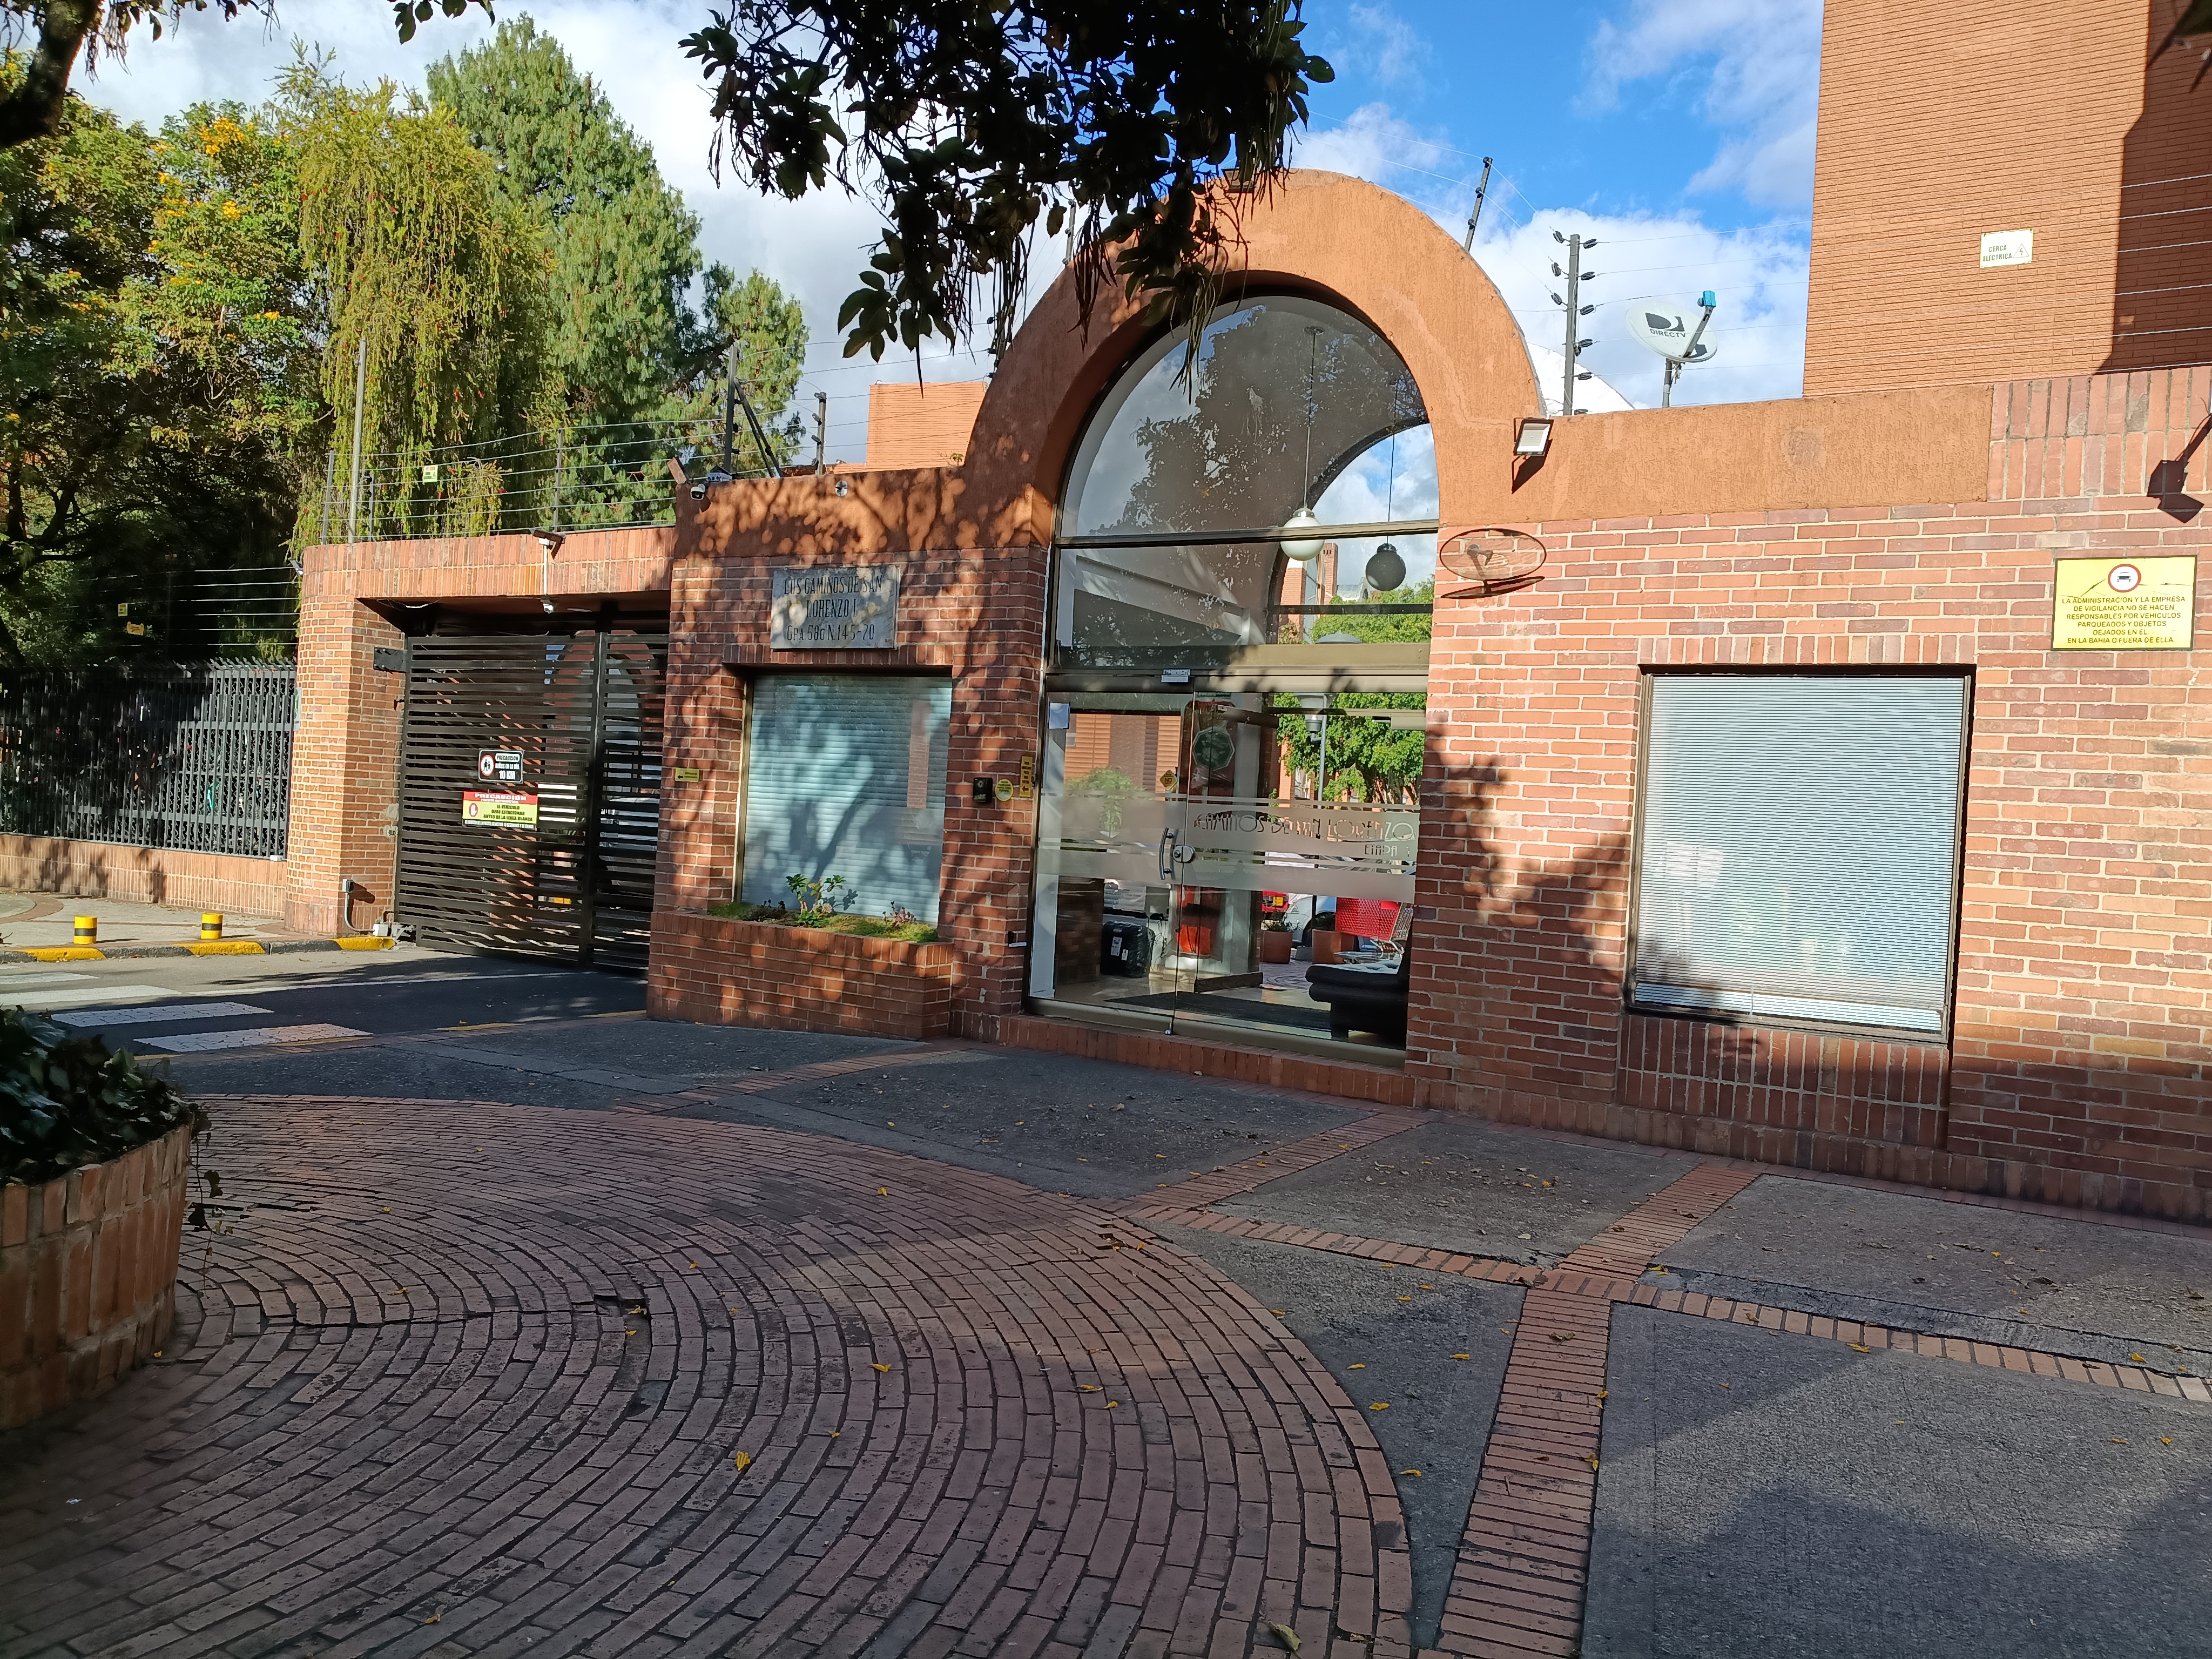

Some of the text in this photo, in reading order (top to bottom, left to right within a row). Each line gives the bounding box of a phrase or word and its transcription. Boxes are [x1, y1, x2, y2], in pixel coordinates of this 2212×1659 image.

[1983, 253, 2012, 261] ELECTRICA
[1650, 328, 1686, 338] DIRECTV
[784, 578, 802, 595] LOS
[848, 576, 860, 593] DE
[862, 575, 882, 593] SAN
[807, 598, 857, 618] LORENZO I
[499, 770, 516, 780] 10 KM
[475, 793, 527, 801] PRECAUCIÓN
[1196, 812, 1265, 833] CAMINOS
[1327, 819, 1414, 841] LORENZO
